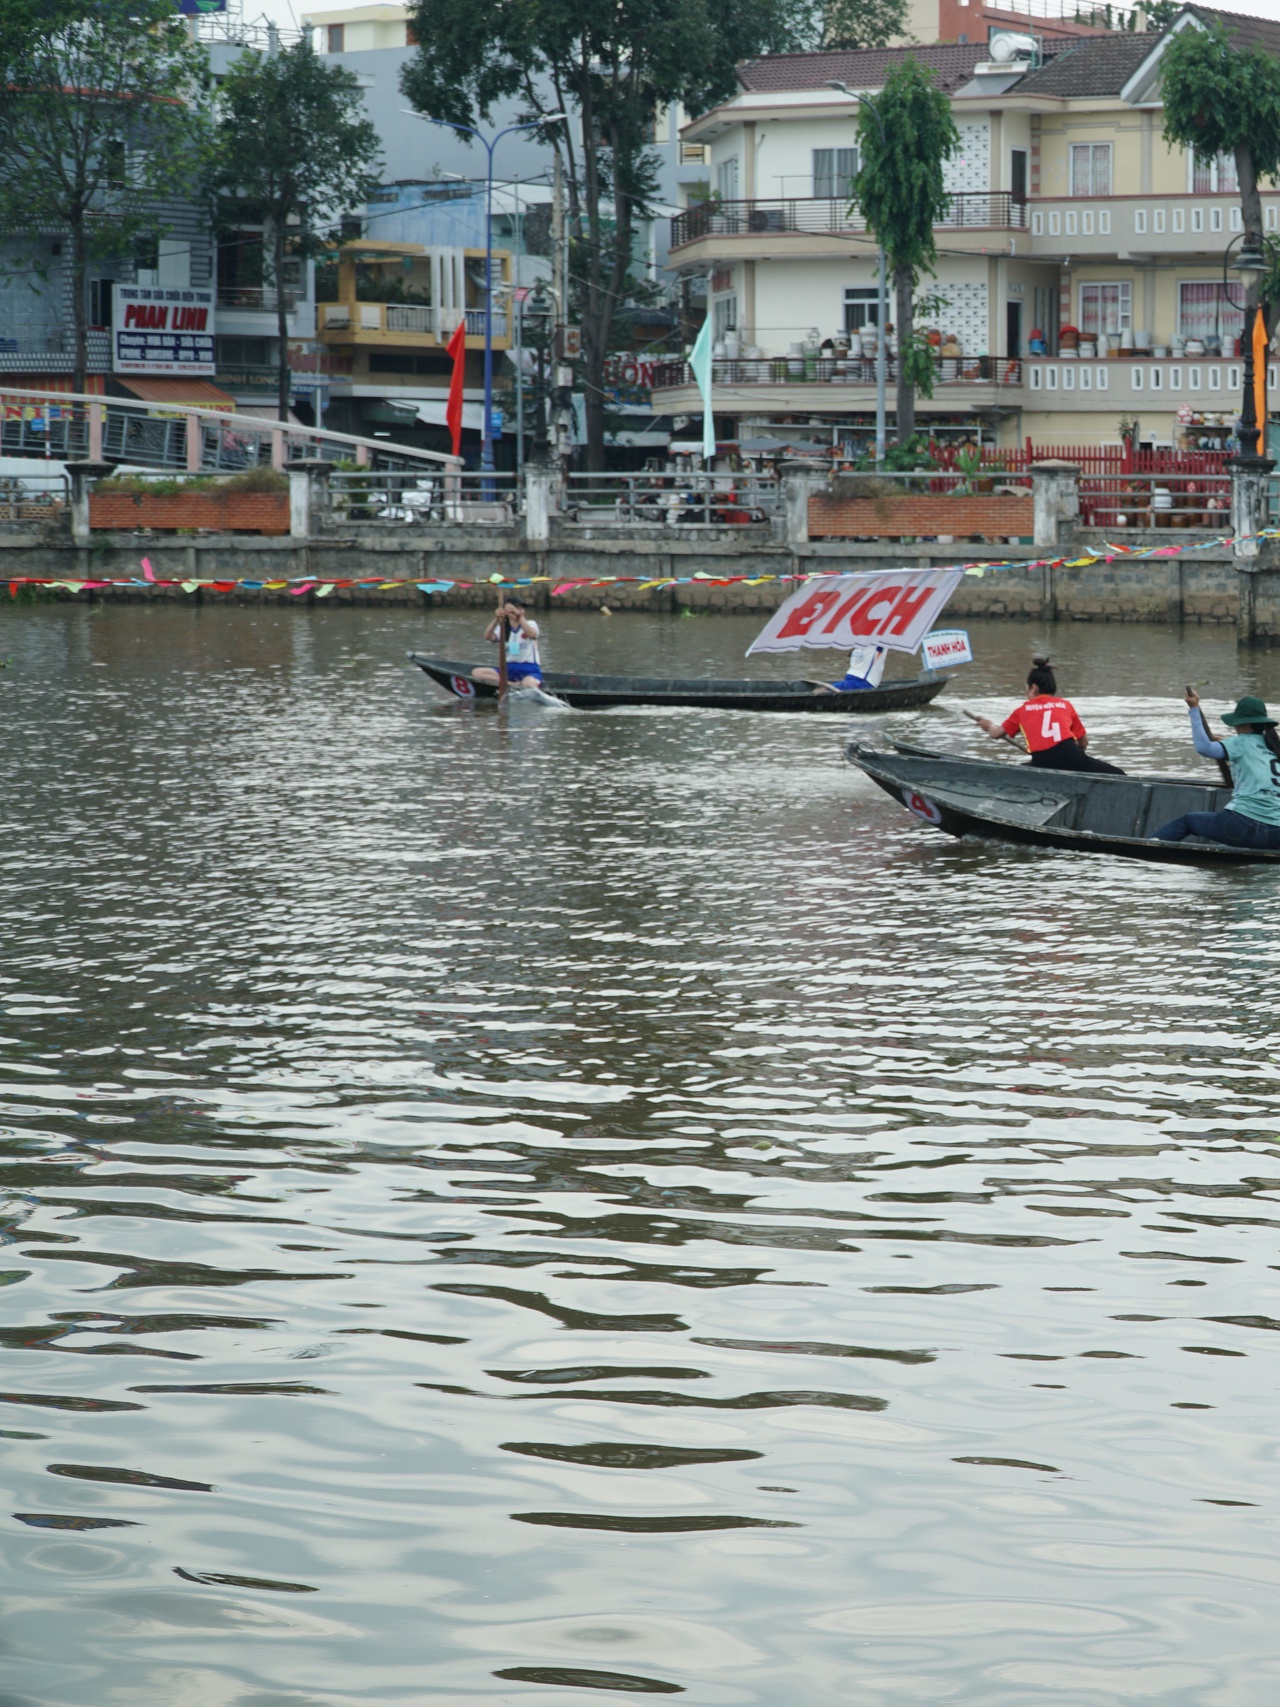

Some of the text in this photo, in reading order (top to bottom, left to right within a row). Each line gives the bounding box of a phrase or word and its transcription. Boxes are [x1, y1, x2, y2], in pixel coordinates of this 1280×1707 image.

[124, 304, 208, 332] PHAN LINH
[454, 676, 470, 694] 8
[1041, 710, 1062, 742] 4
[911, 793, 935, 818] 4
